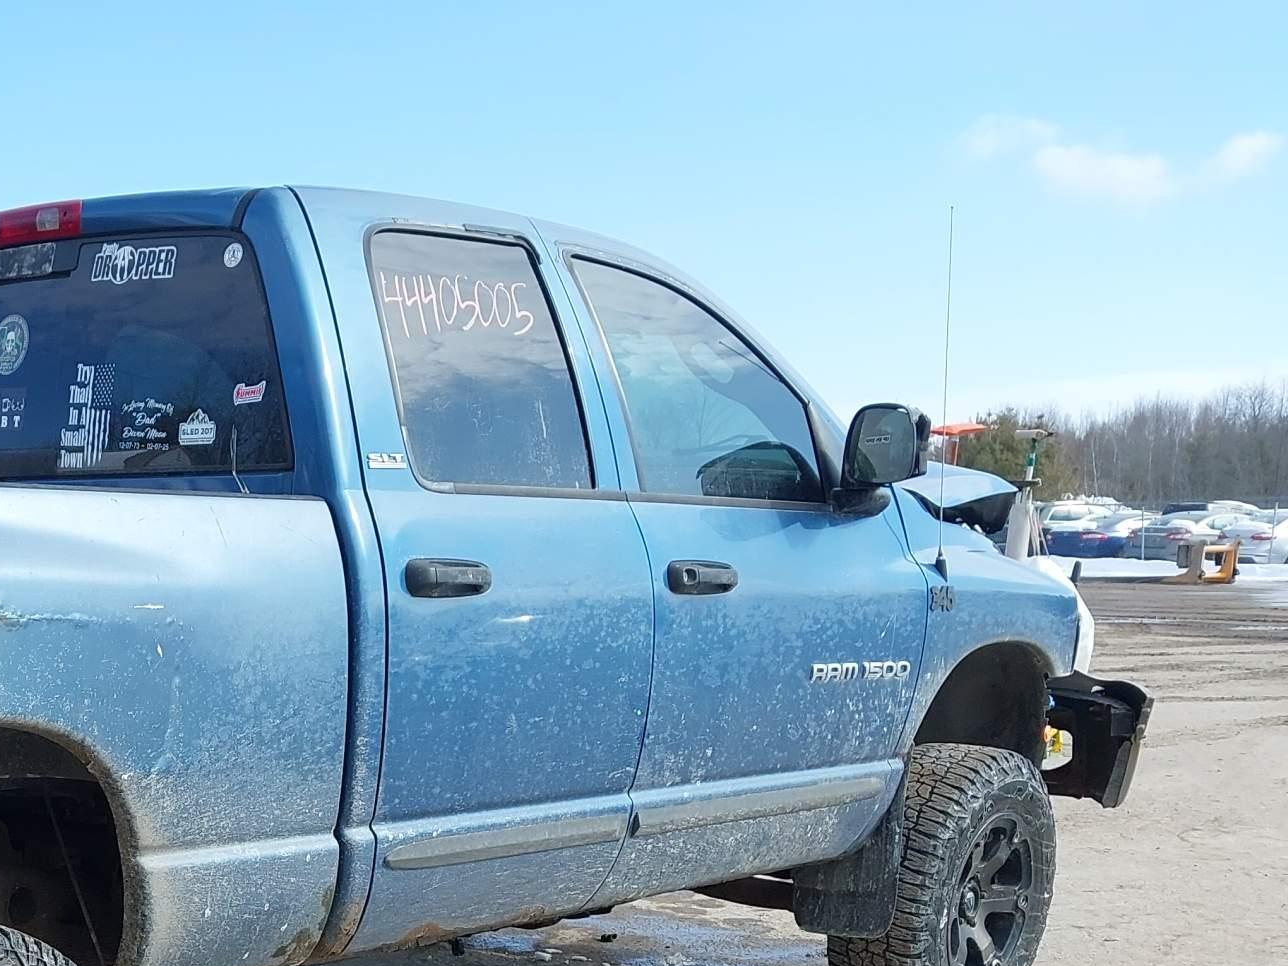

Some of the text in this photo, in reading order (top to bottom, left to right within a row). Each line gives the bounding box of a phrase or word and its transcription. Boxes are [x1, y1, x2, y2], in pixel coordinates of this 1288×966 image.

[380, 271, 534, 338] 44405005
[77, 363, 94, 384] Try
[69, 385, 89, 404] That
[68, 406, 87, 425] In A
[60, 428, 86, 447] Small
[60, 450, 84, 469] Town
[810, 660, 911, 684] RAM 1500
